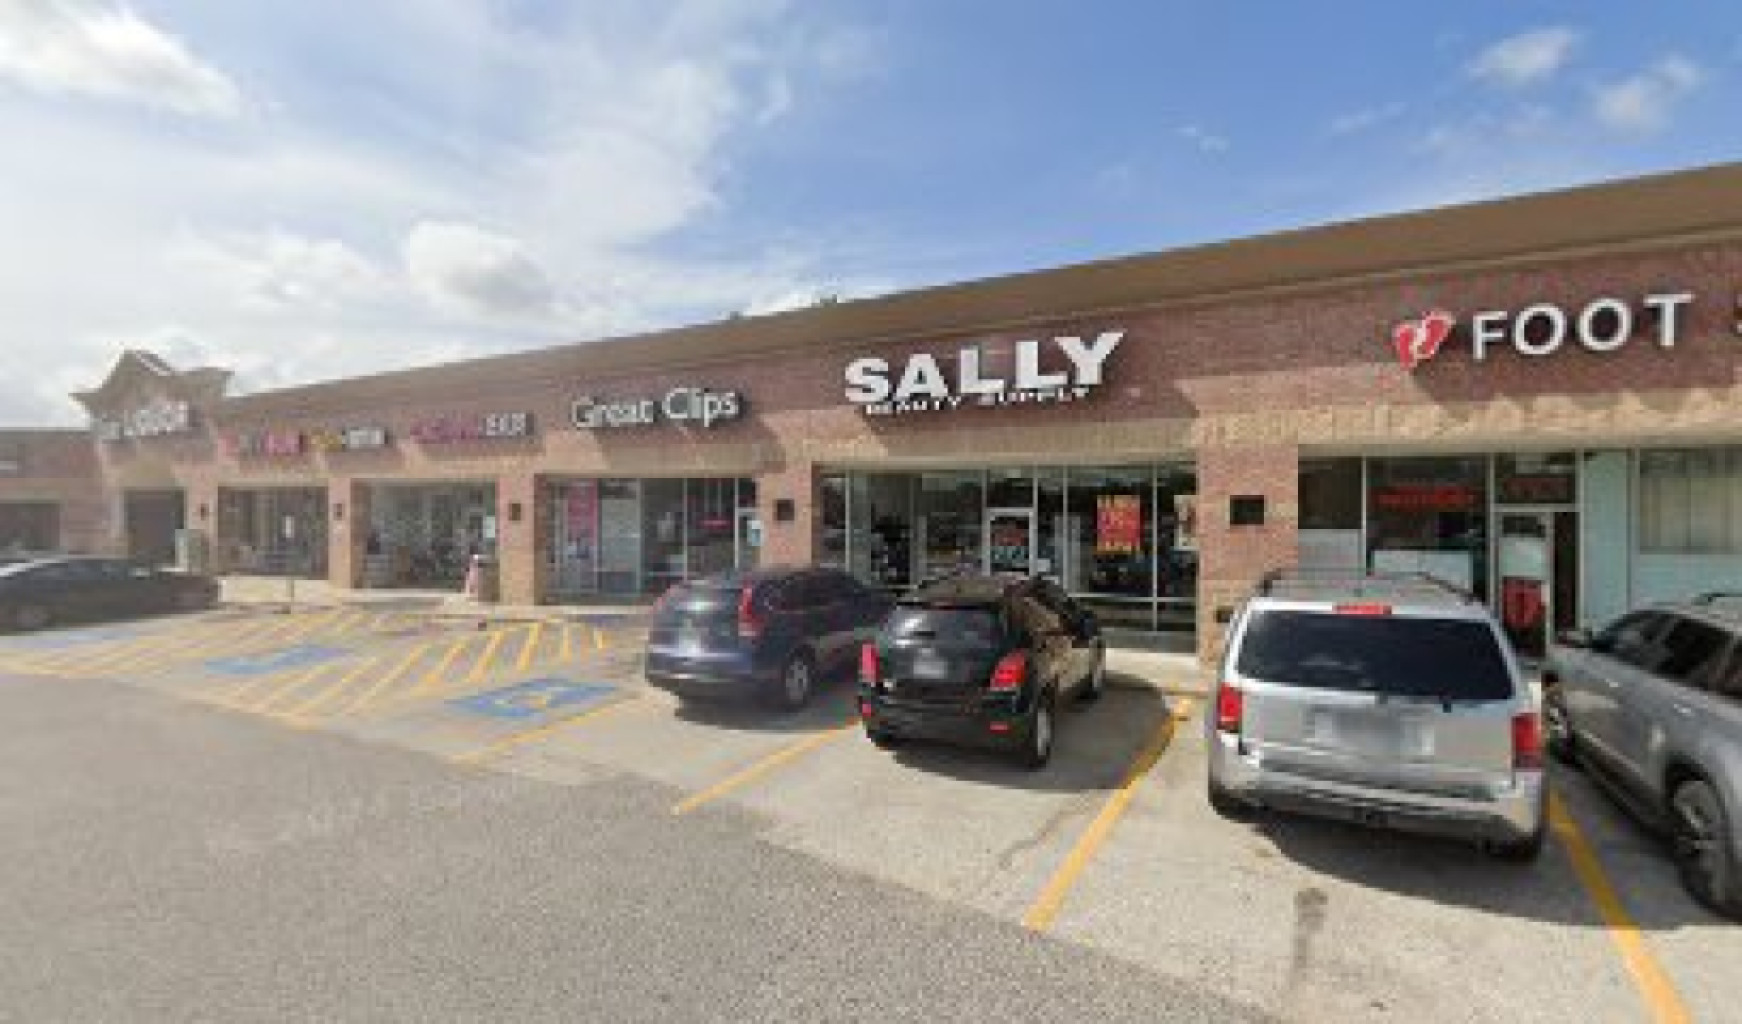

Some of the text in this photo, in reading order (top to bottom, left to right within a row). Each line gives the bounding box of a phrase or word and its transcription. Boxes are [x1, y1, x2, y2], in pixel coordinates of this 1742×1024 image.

[1472, 291, 1695, 361] FOOT
[845, 330, 1126, 402] SALLY
[571, 396, 655, 429] Great
[662, 387, 740, 428] Clips
[865, 396, 962, 415] BEAUTY
